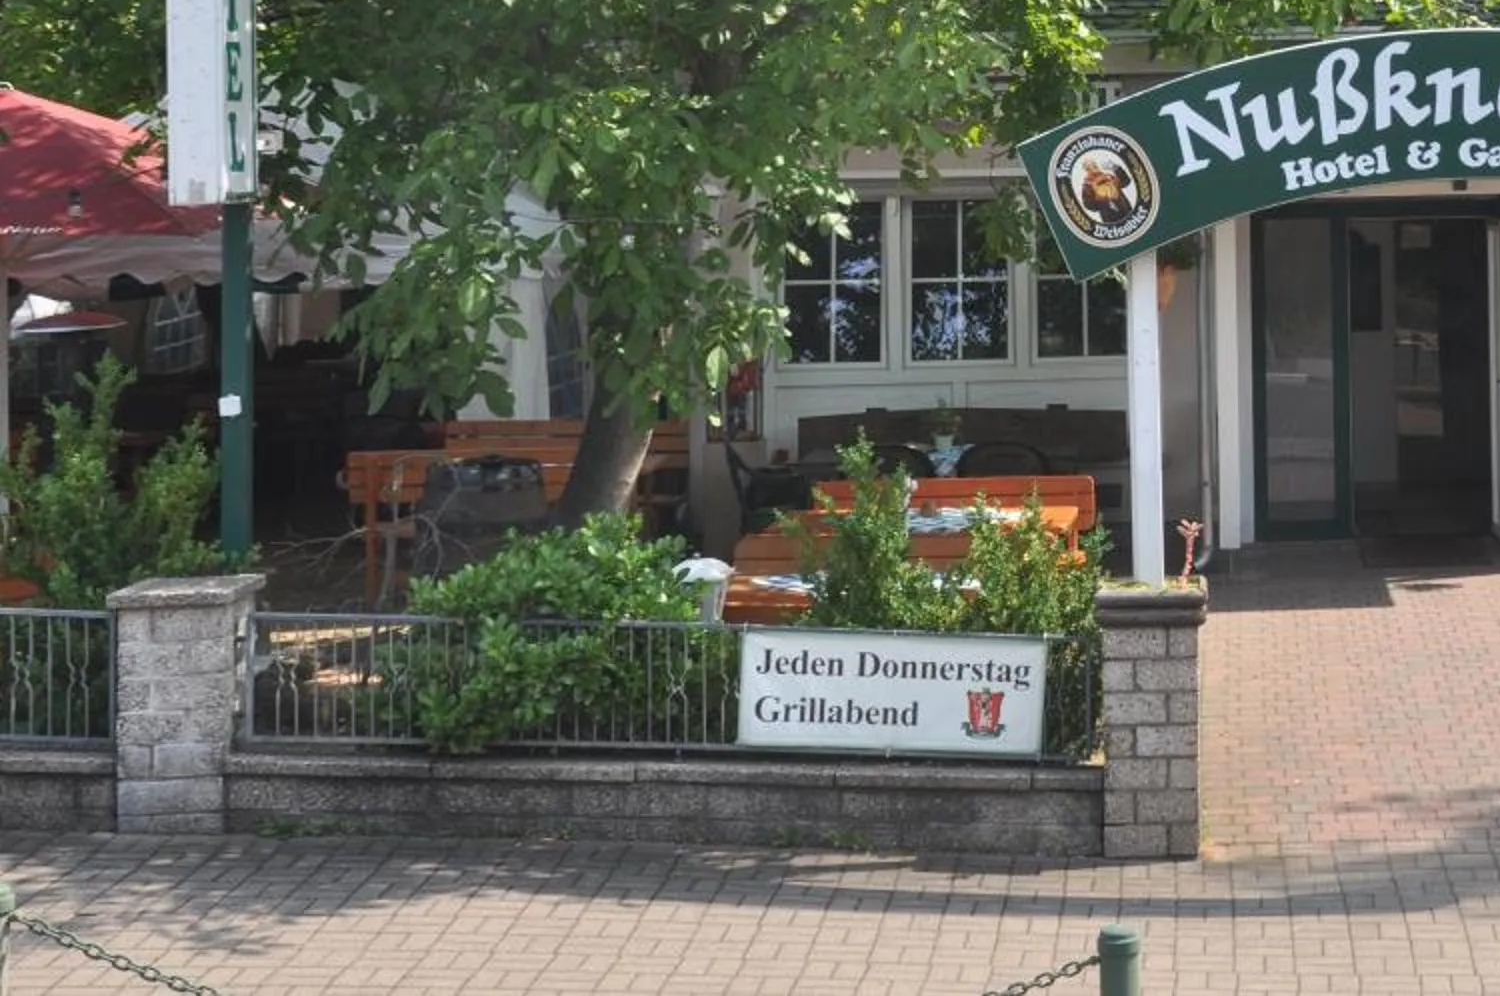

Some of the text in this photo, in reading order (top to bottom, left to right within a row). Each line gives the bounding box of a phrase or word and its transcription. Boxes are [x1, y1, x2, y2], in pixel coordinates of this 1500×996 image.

[1281, 144, 1391, 191] Hotel
[1407, 140, 1441, 171] &
[755, 648, 1032, 689] Jeden Donnerstag
[754, 694, 919, 727] Grillabend
